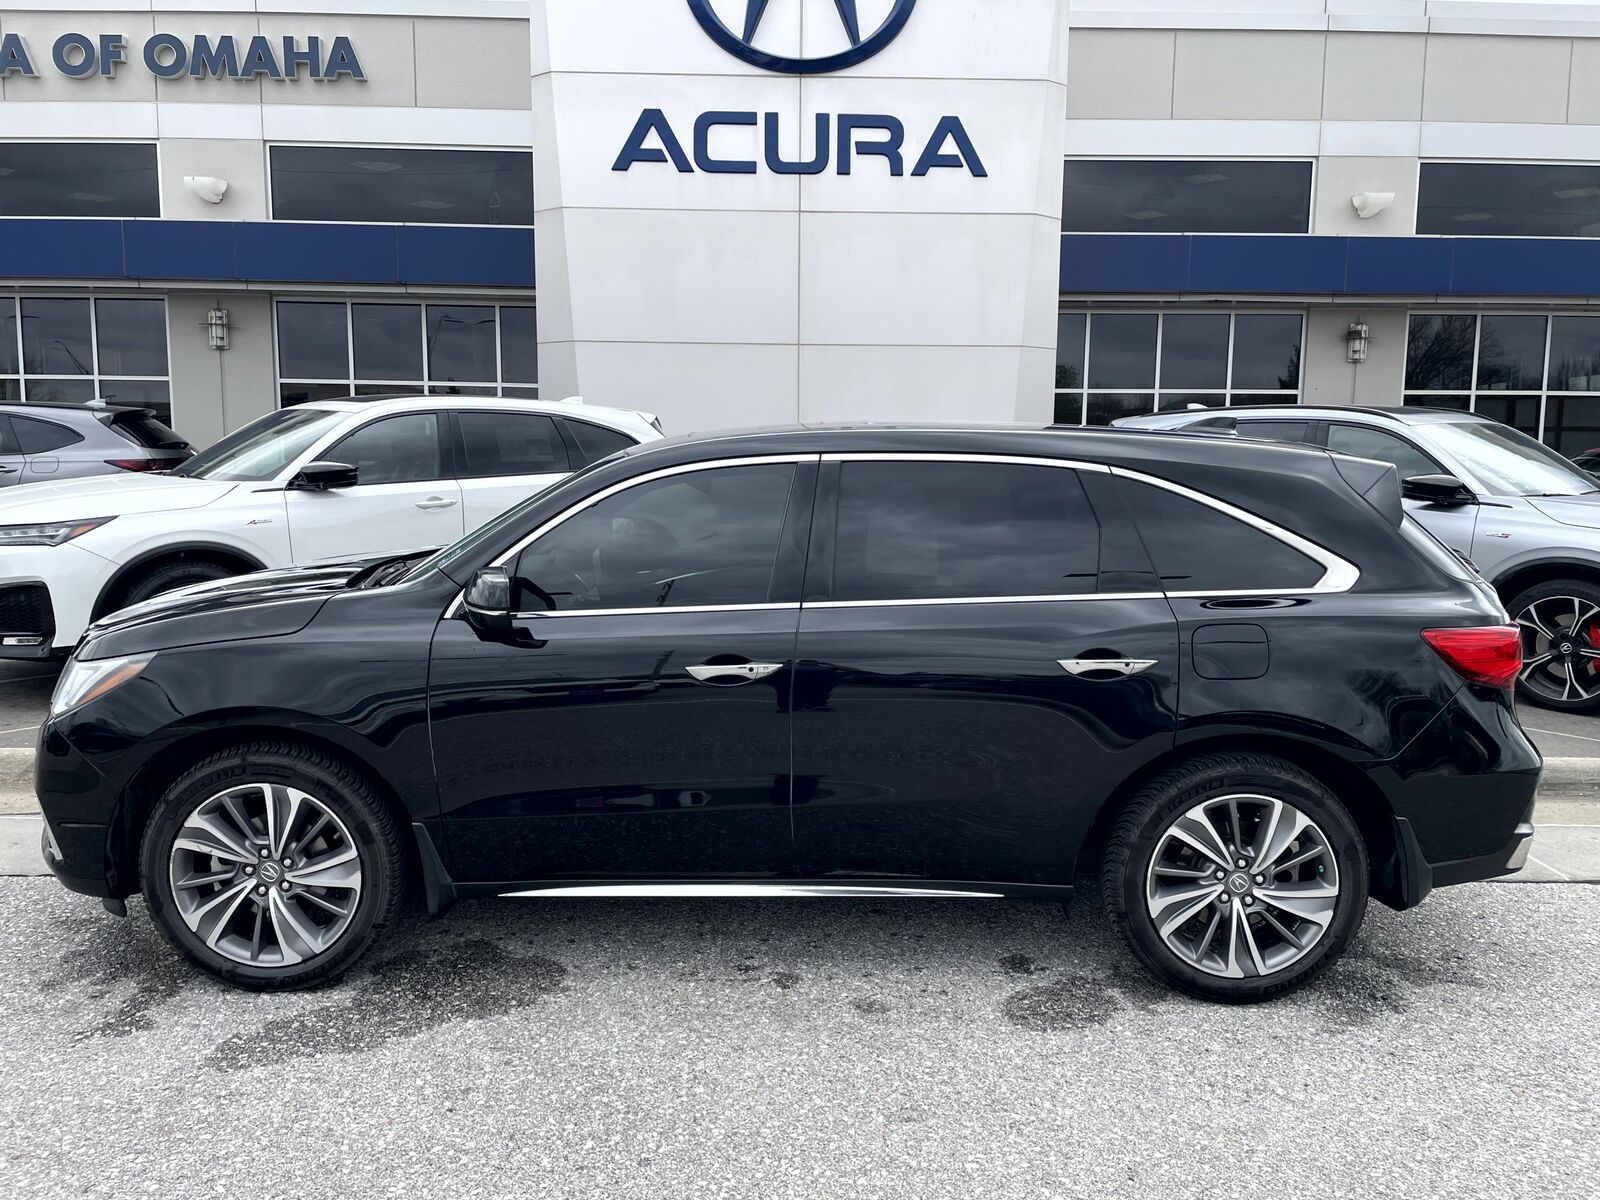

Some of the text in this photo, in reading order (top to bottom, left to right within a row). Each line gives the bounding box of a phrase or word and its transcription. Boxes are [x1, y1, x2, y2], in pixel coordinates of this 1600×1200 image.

[52, 32, 127, 79] OF
[143, 33, 367, 82] OMAHA
[612, 108, 988, 177] ACURA
